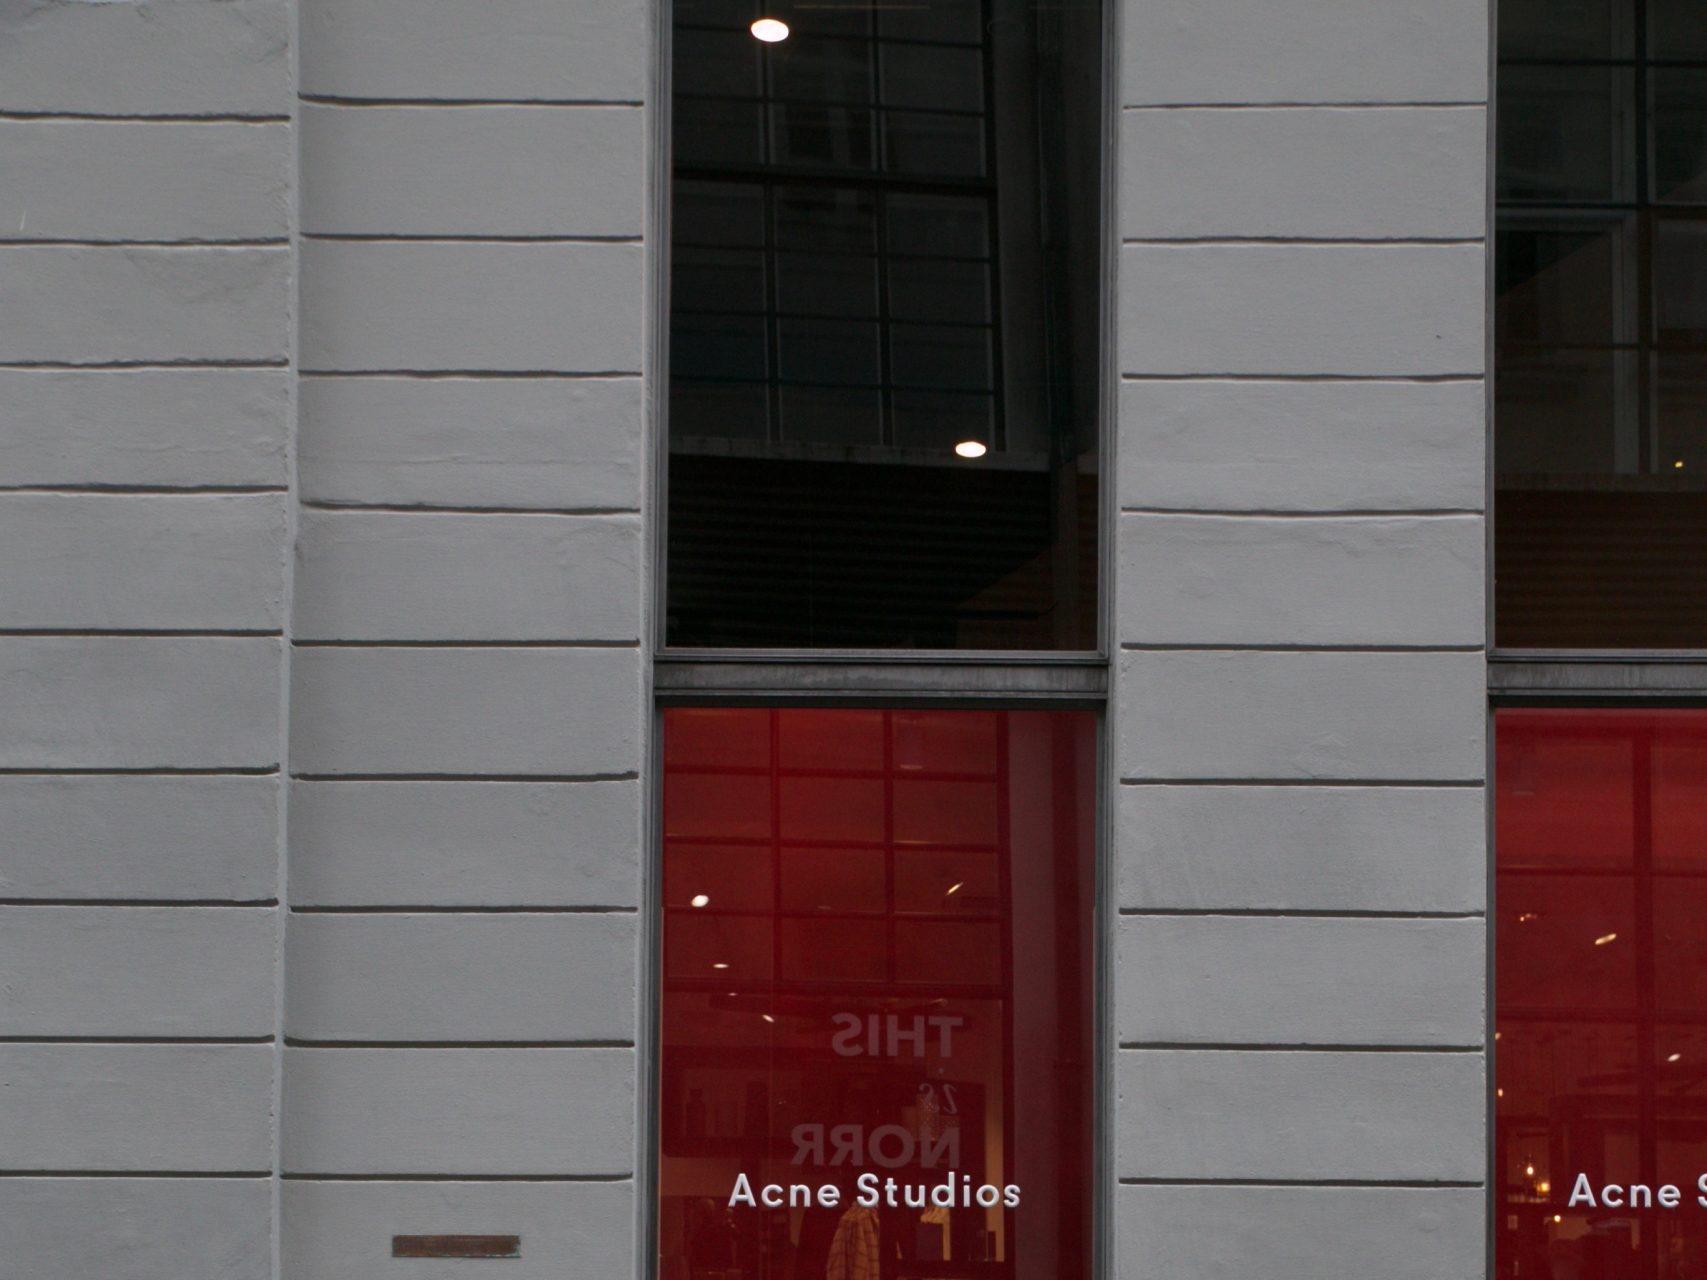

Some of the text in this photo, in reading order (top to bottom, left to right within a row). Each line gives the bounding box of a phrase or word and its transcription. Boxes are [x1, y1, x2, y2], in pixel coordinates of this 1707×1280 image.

[727, 1171, 1022, 1208] Acne Studios
[1567, 1172, 1682, 1208] Acne
